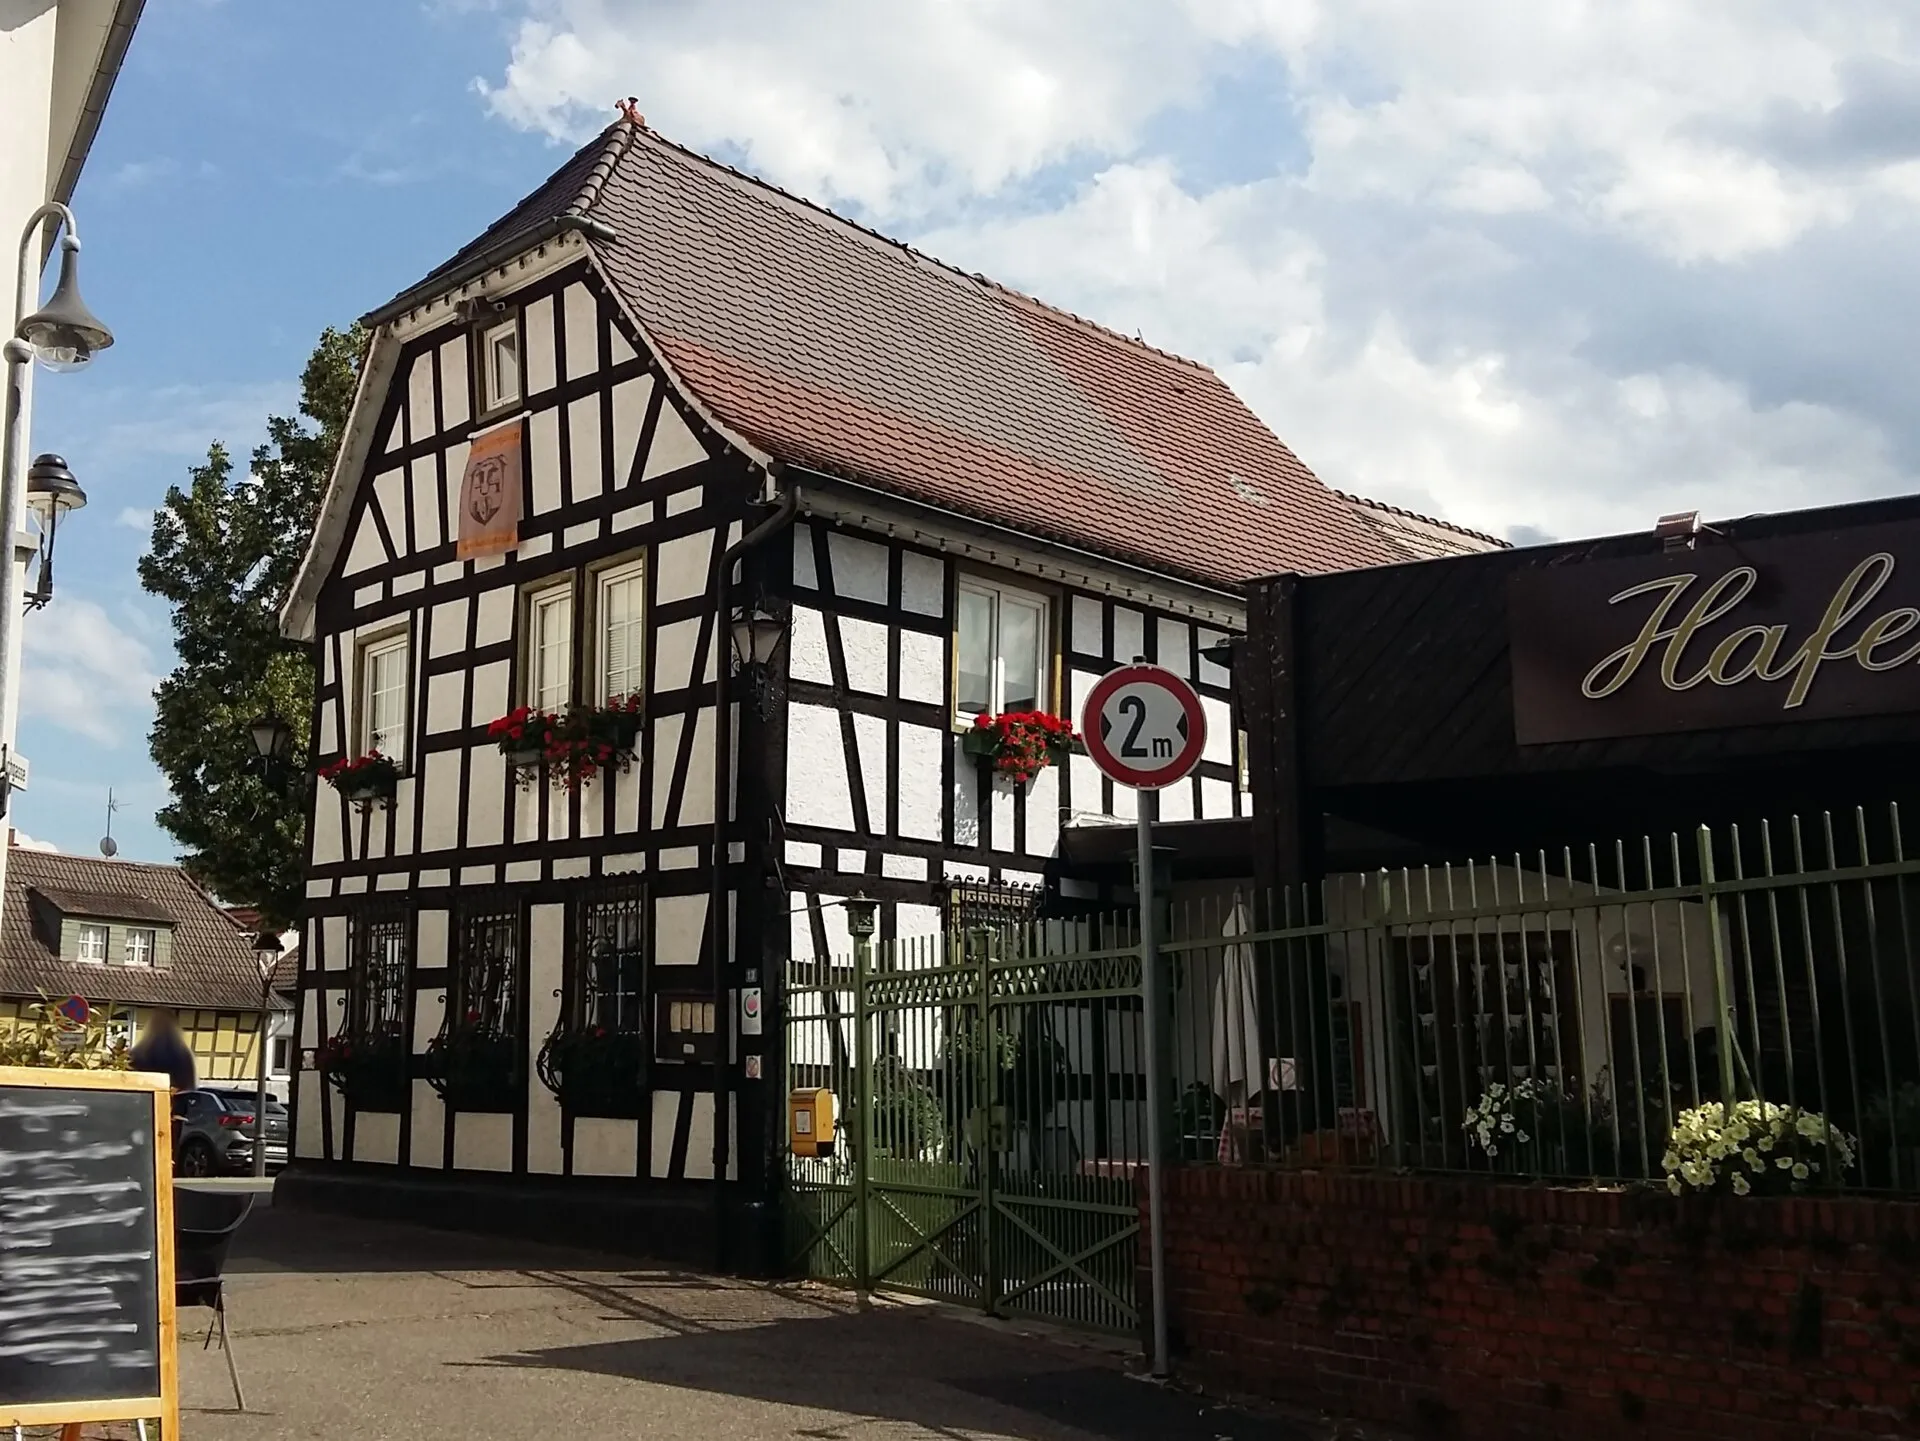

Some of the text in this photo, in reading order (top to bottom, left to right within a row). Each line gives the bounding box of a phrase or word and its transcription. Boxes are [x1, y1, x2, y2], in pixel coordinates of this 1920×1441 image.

[1581, 552, 1920, 709] Hafe
[1118, 695, 1173, 758] 2 m
